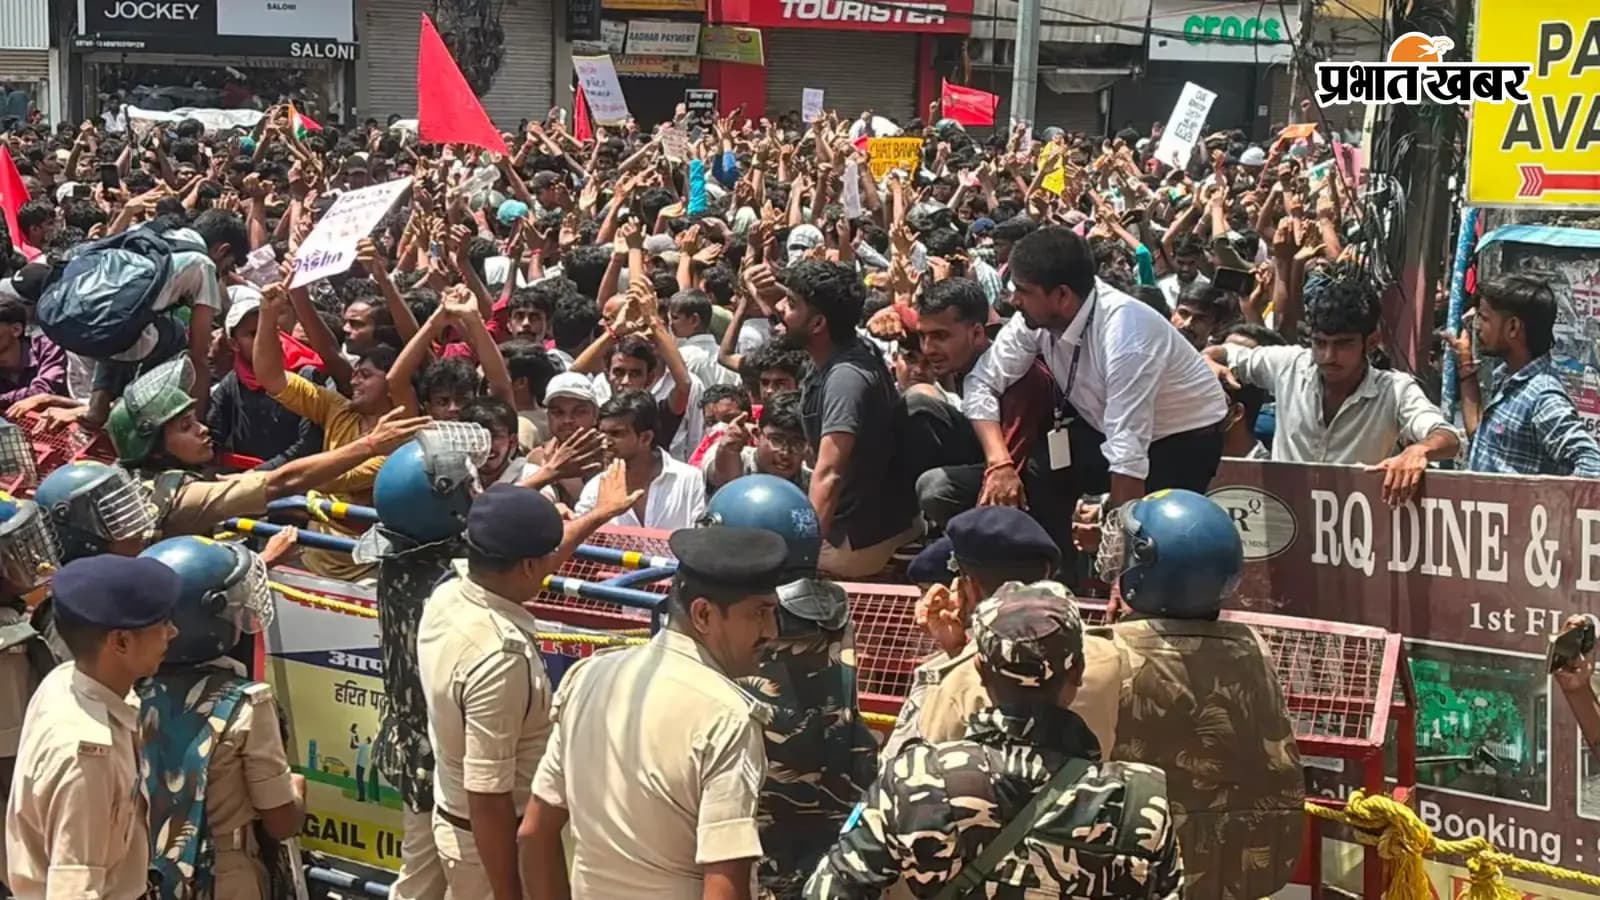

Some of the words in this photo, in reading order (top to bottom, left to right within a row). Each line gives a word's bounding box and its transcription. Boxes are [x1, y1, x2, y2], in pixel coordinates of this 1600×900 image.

[104, 1, 200, 20] JOCKEY
[780, 0, 947, 24] TOURISTER
[660, 32, 697, 43] PAYMENT
[1184, 15, 1281, 46] crocs
[290, 42, 355, 60] SALONI
[1311, 489, 1375, 577] RQ
[1387, 498, 1509, 583] DINE
[1524, 504, 1562, 589] &
[1469, 602, 1516, 633] 1st
[334, 680, 368, 707] हरित
[303, 813, 366, 849] GAIL
[1420, 800, 1561, 864] Booking
